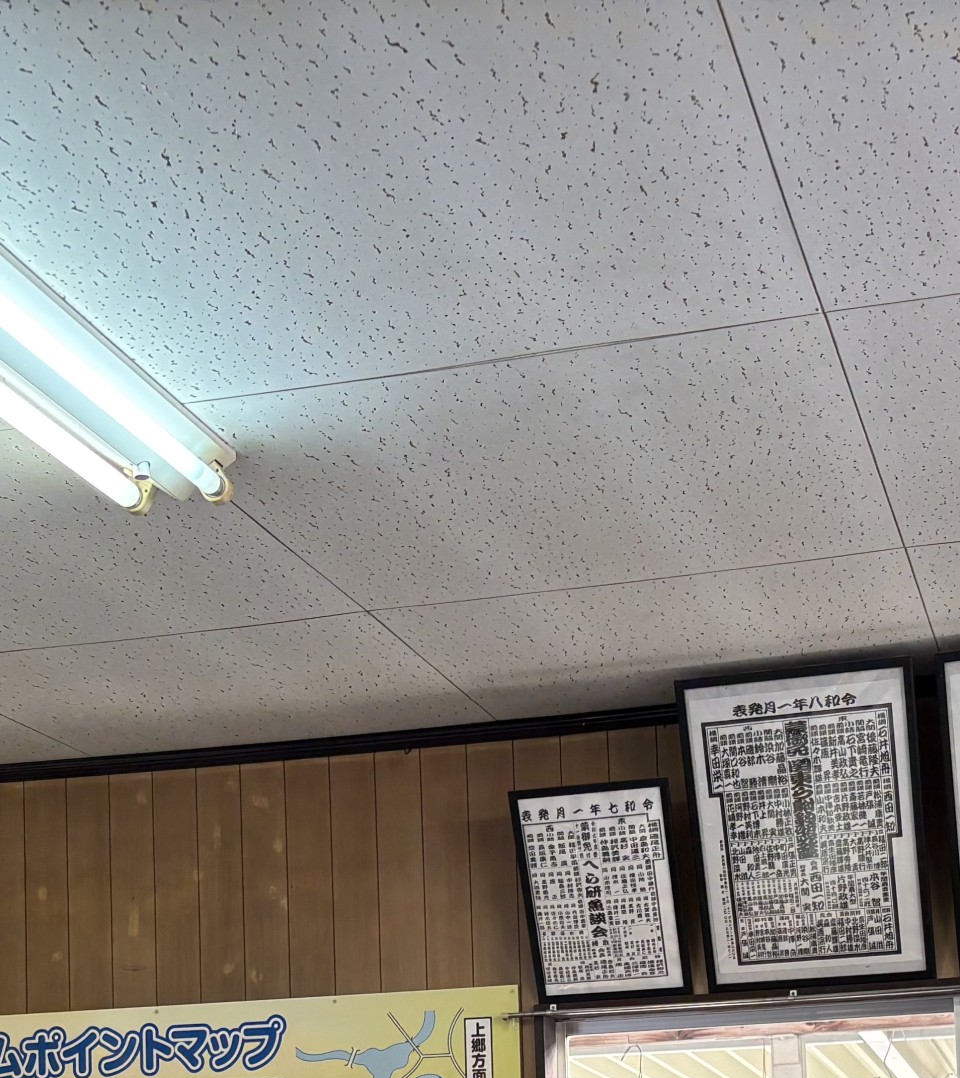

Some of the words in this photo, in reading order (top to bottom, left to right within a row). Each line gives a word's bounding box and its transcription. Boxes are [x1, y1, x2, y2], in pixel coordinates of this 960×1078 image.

[733, 693, 857, 718] 令和八年一月発表
[521, 798, 654, 822] 令和七年一月発表
